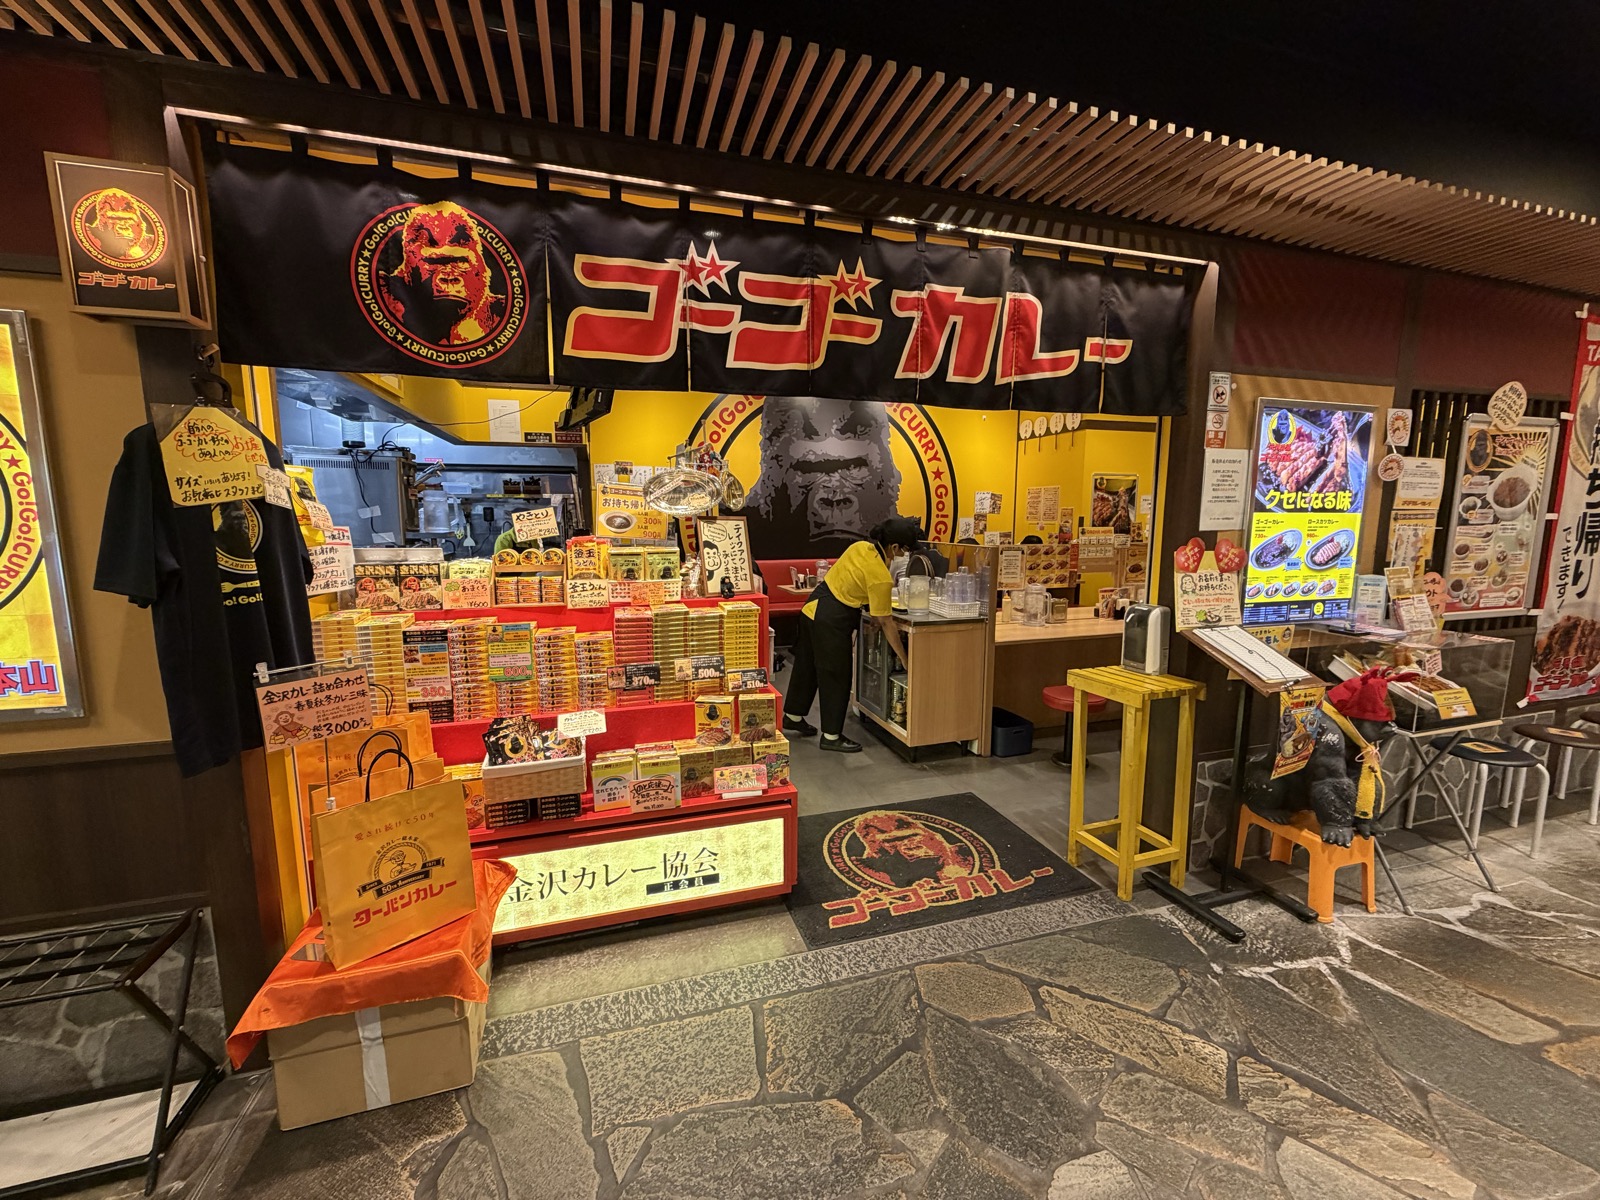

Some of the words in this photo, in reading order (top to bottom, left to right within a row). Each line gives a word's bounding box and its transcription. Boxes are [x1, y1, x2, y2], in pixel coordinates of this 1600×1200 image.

[78, 270, 176, 291] ゴーゴーカレー
[357, 257, 397, 338] Go!Go!CURRY
[563, 239, 1133, 386] ゴーゴーカレー
[494, 277, 525, 350] Go!Go!CURRY
[403, 338, 488, 363] Go!Go!CURRY
[515, 510, 549, 521] やきとり
[1265, 489, 1353, 511] クセになる味
[262, 675, 366, 706] 金沢カレー詰め合わせ
[294, 689, 369, 712] 春夏秋冬カレー三昧
[504, 847, 720, 904] 金沢カレー協会
[663, 876, 704, 893] 正会員
[353, 880, 457, 929] ターバンカレー
[822, 866, 1055, 929] ゴーゴーカレー
